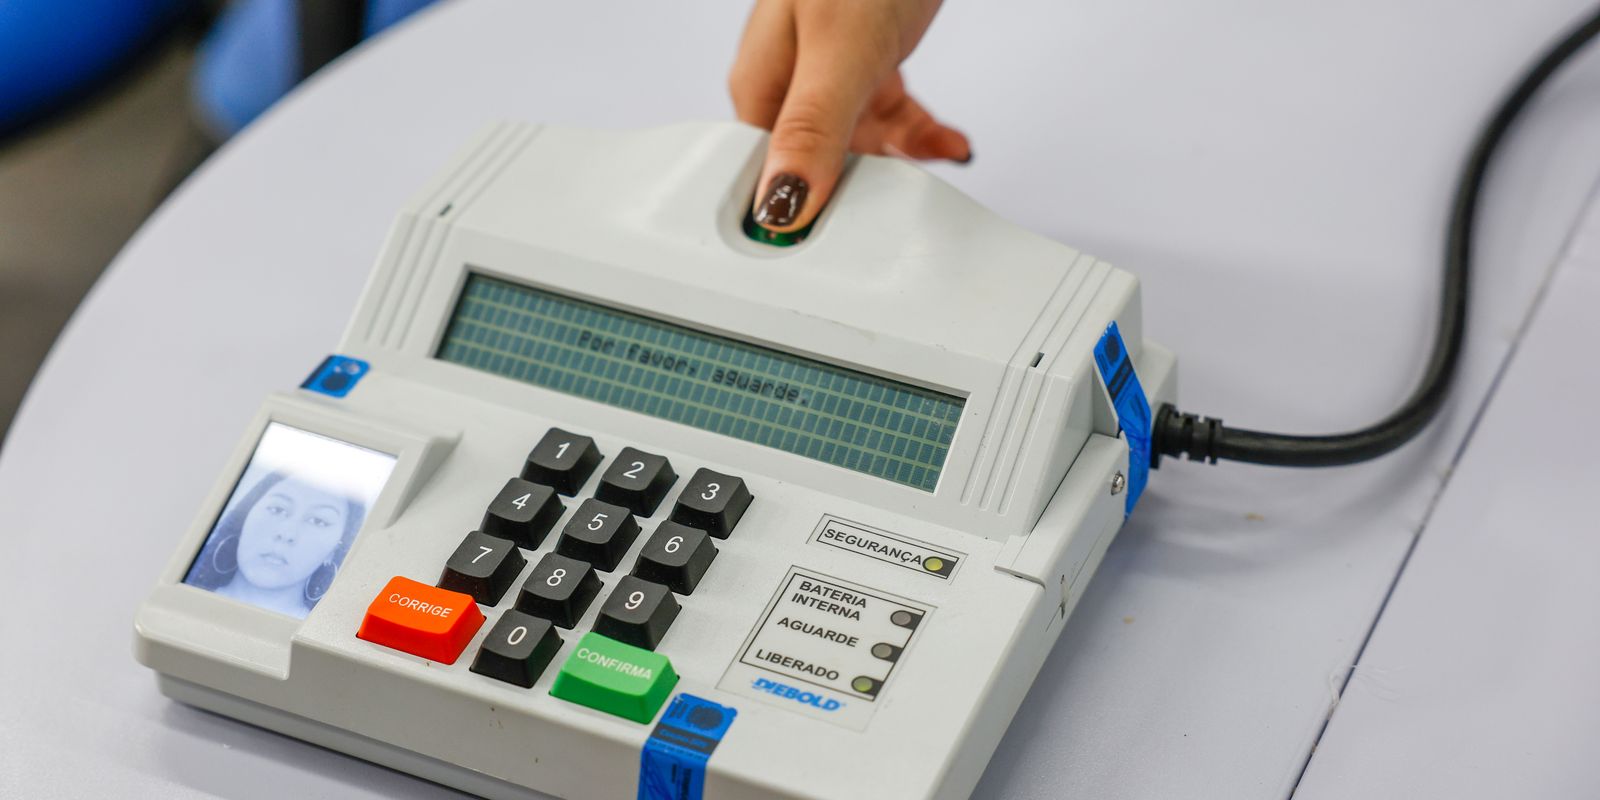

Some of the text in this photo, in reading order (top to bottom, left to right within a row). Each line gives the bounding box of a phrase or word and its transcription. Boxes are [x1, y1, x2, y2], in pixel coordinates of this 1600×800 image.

[577, 330, 615, 353] Por
[711, 367, 807, 405] aguarde.
[555, 441, 571, 459] 1
[622, 460, 645, 479] 2
[511, 493, 532, 511] 4
[701, 483, 720, 501] 3
[587, 513, 608, 532] 5
[470, 546, 493, 564] 7
[664, 535, 683, 554] 6
[824, 528, 922, 566] SEGURANÇA
[546, 568, 567, 587] 8
[624, 590, 645, 611] 9
[799, 580, 867, 608] BATERIA
[388, 593, 453, 618] CORRIGE
[791, 592, 860, 621] INTERNA
[507, 626, 528, 646] 0
[777, 616, 859, 647] AGUARDE
[576, 647, 653, 681] CONFIRMA
[755, 649, 840, 681] LIBERADO
[752, 677, 842, 712] DIEBOLD
